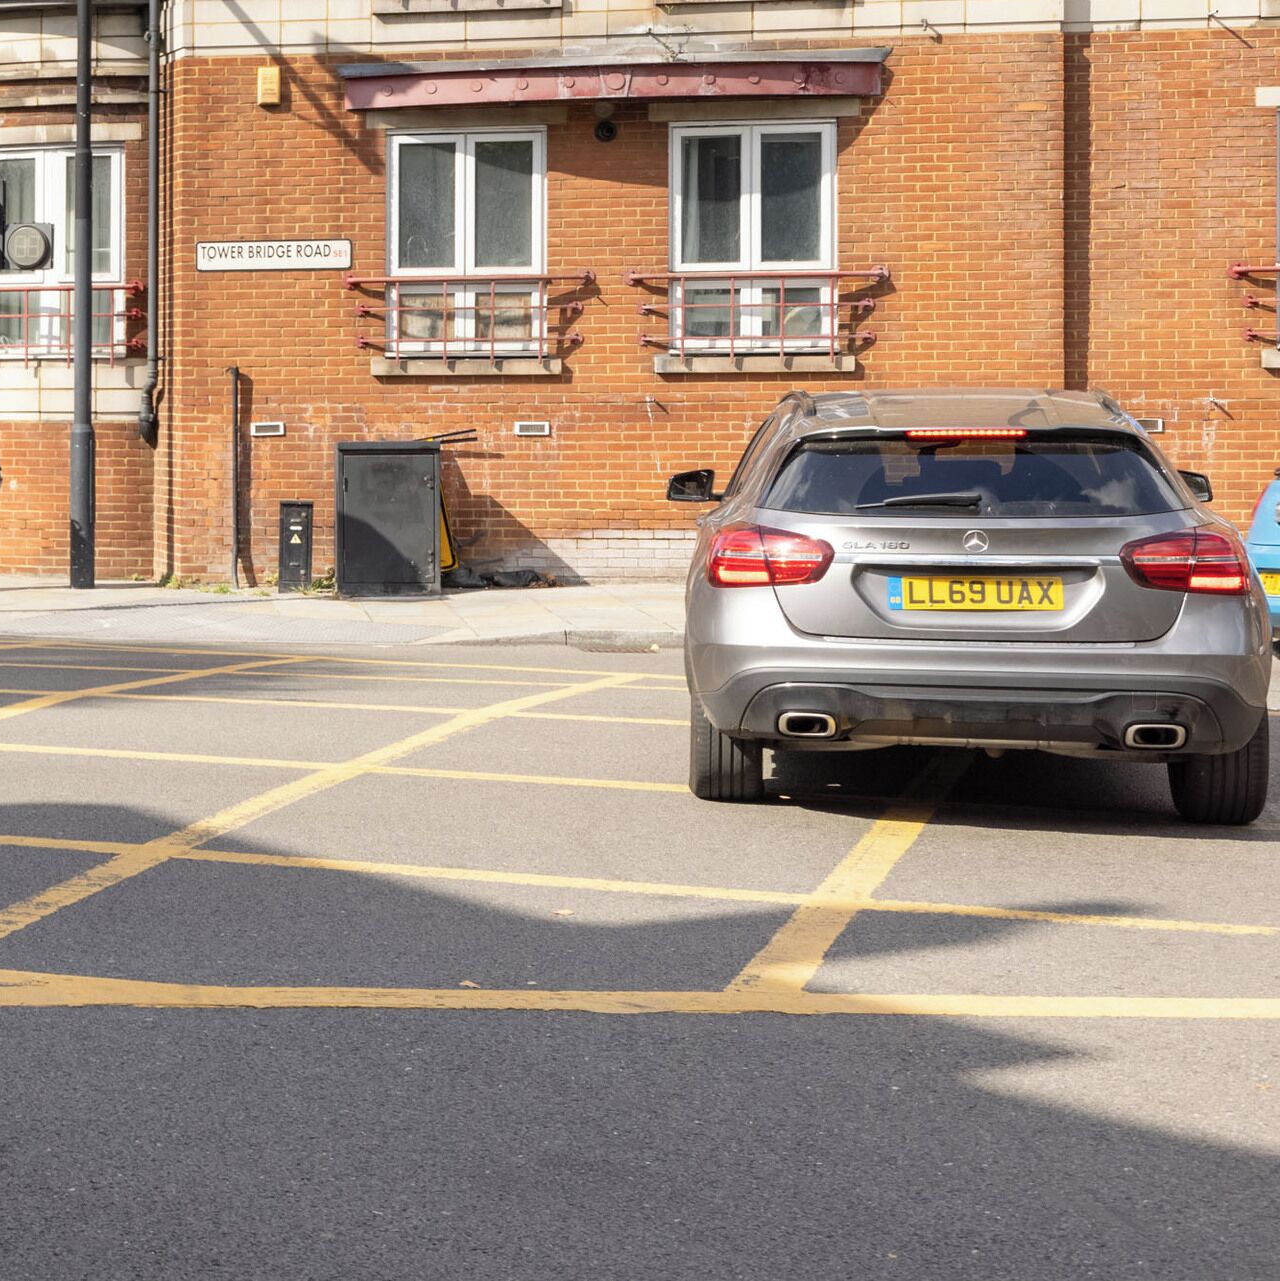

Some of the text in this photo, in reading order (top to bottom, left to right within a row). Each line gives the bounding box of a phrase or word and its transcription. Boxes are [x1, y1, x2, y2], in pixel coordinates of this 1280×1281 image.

[201, 244, 348, 259] TOWER BRIDGE ROAD SE1
[842, 541, 910, 550] GLA 180
[908, 579, 1054, 606] LL69 UAX
